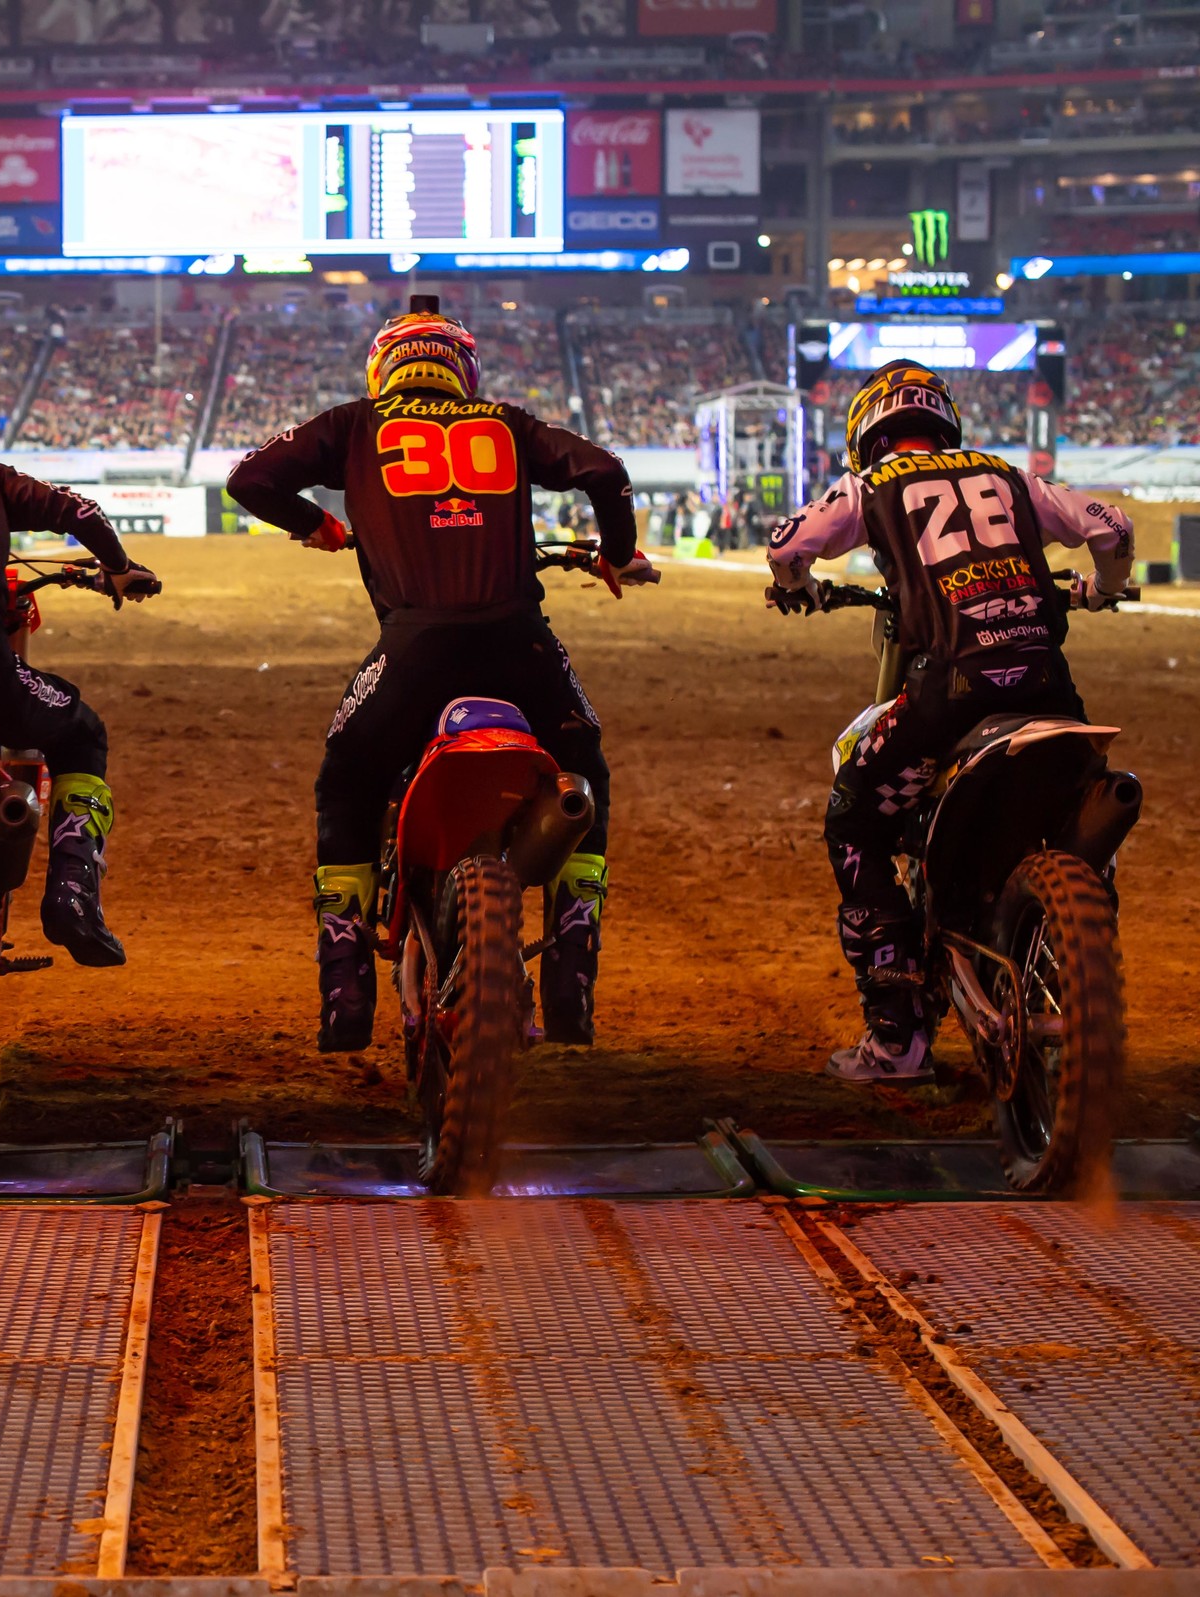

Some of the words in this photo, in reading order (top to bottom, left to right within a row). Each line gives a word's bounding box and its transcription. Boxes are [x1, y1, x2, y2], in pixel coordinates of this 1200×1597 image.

[568, 210, 658, 231] GEICO
[392, 340, 458, 362] BRANDON
[376, 418, 517, 497] 30
[870, 452, 1010, 486] MOSIMAN
[430, 513, 457, 528] Red
[457, 512, 483, 526] Bull
[903, 474, 1020, 566] 28
